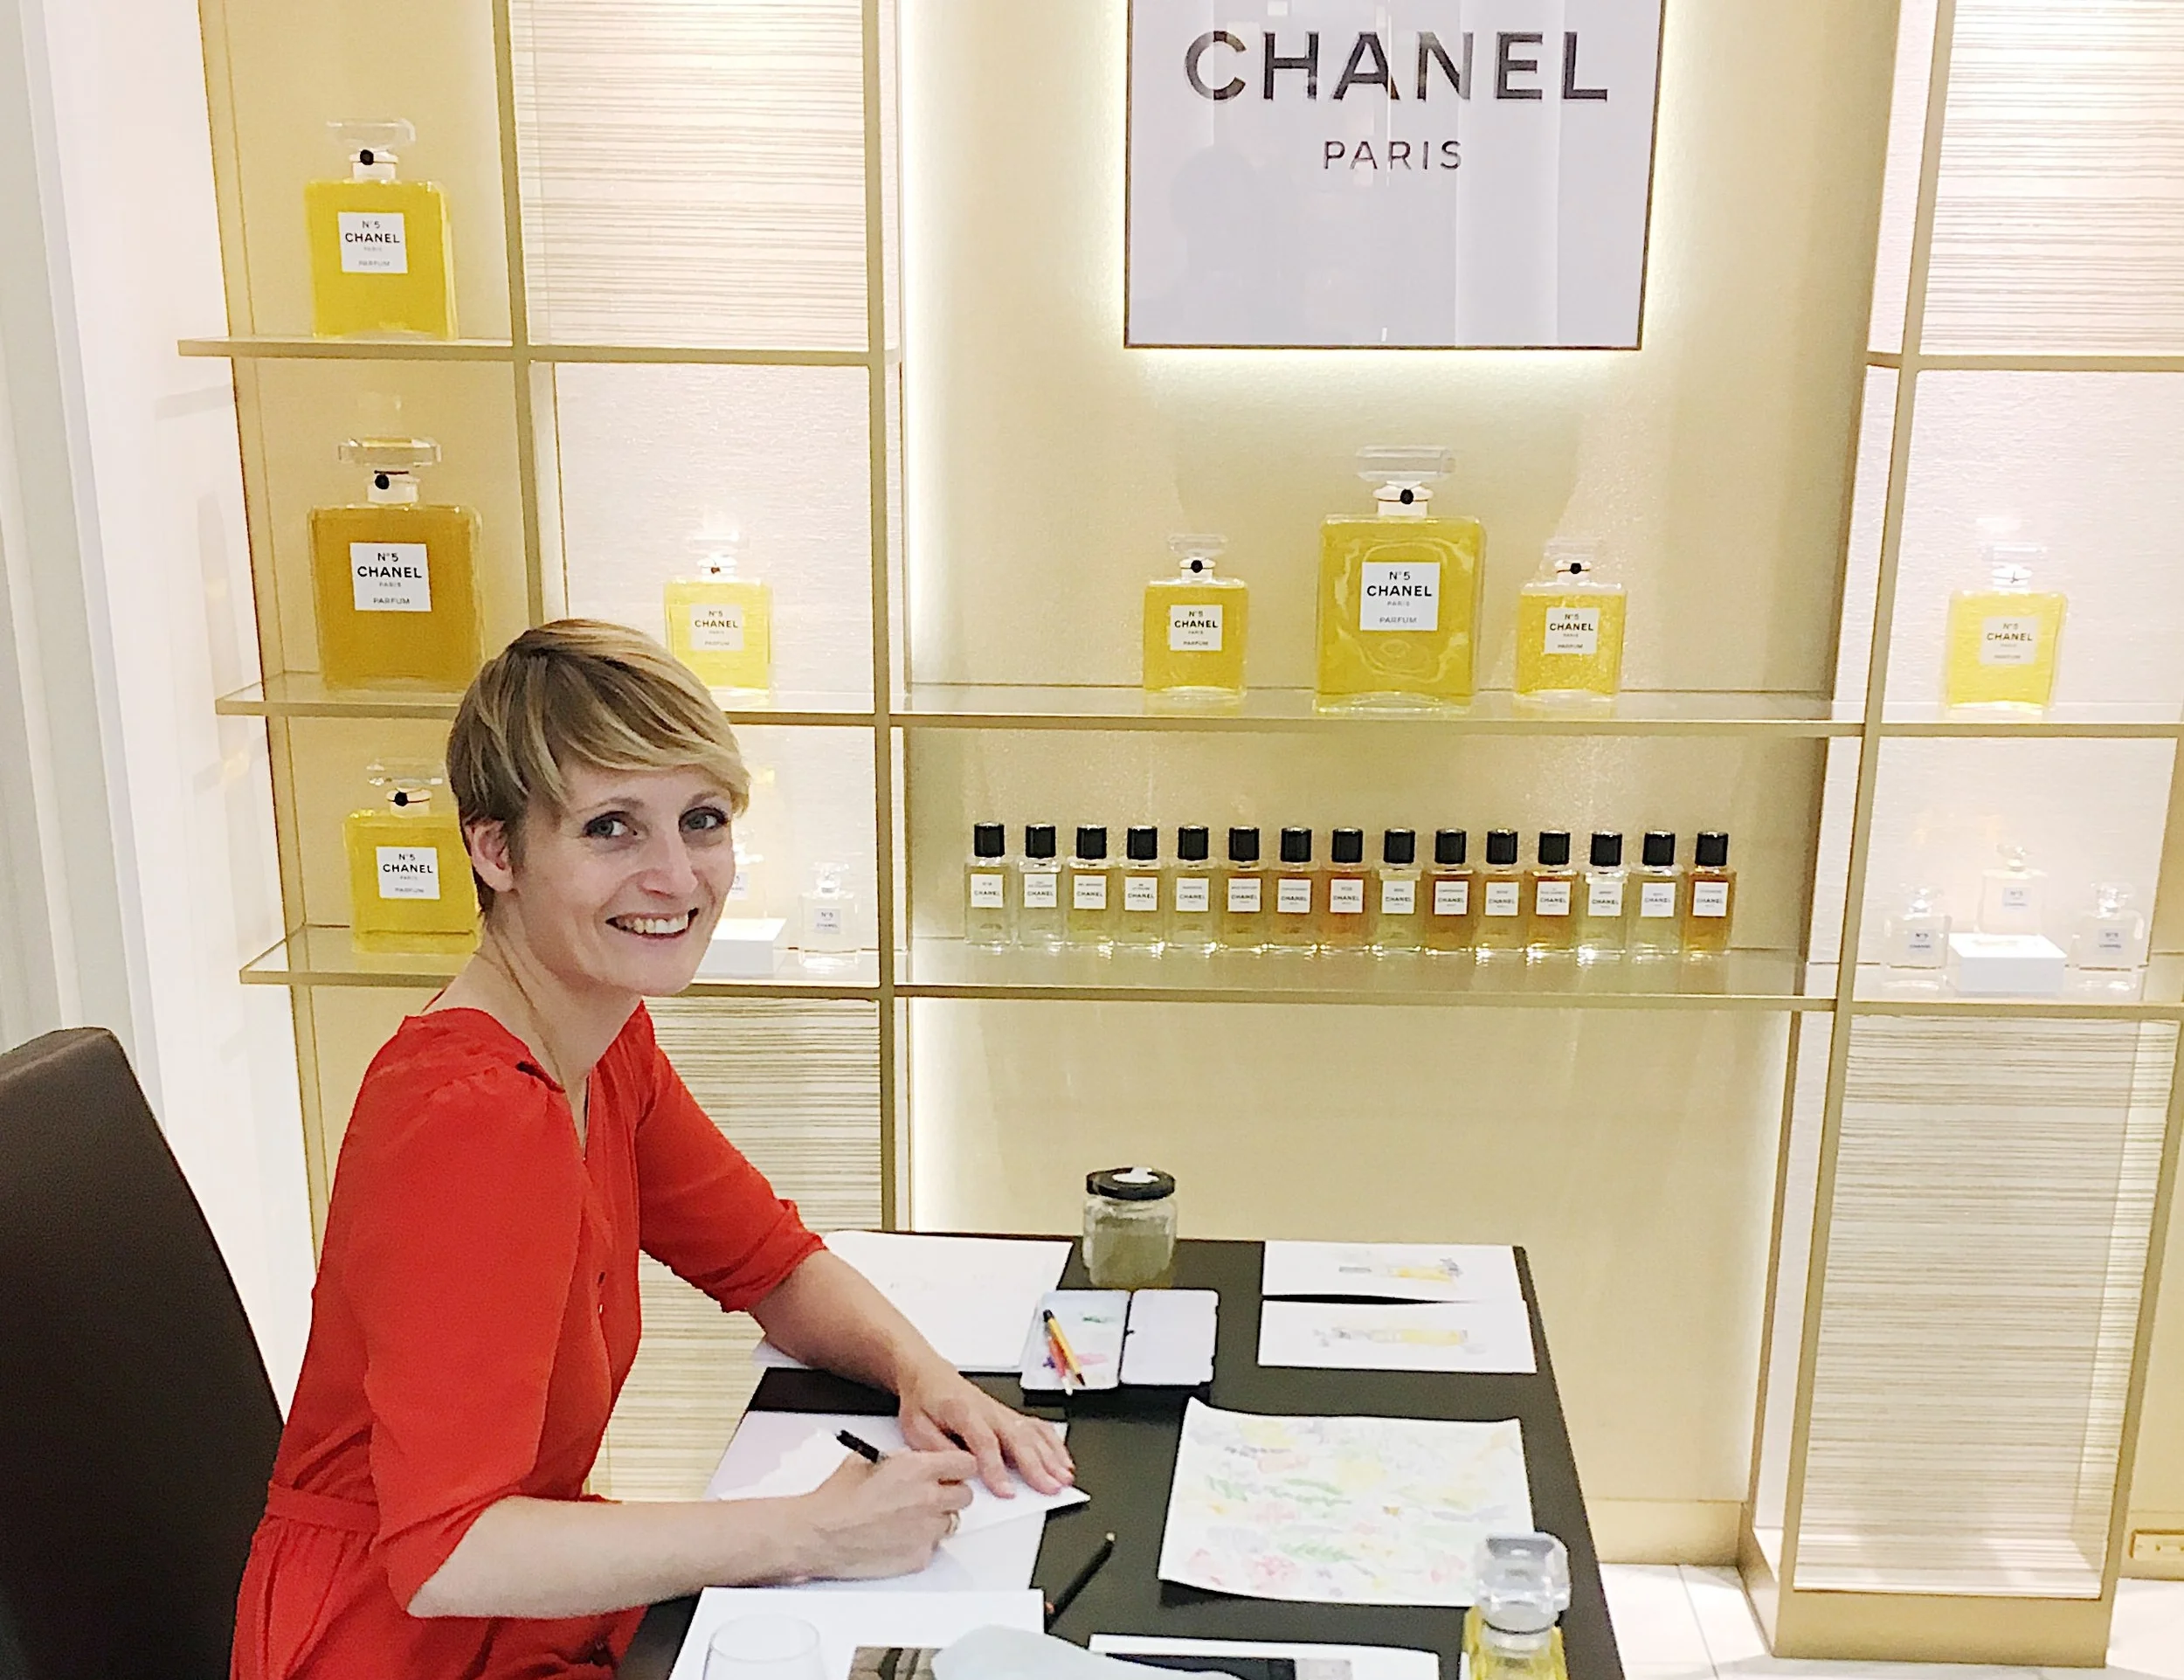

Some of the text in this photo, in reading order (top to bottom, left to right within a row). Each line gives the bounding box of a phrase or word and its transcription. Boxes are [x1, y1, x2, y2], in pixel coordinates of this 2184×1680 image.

[1184, 30, 1608, 102] CHANEL
[1323, 141, 1463, 170] PARIS
[345, 232, 401, 244] CHANEL
[357, 566, 422, 579] CHANEL
[1366, 584, 1433, 598] CHANEL
[373, 597, 411, 605] PARFUM
[695, 619, 739, 629] CHANEL
[1174, 619, 1219, 628] CHANEL
[1549, 622, 1594, 632] CHANEL
[1987, 632, 2033, 641] CHANEL
[383, 863, 434, 875] CHANEL
